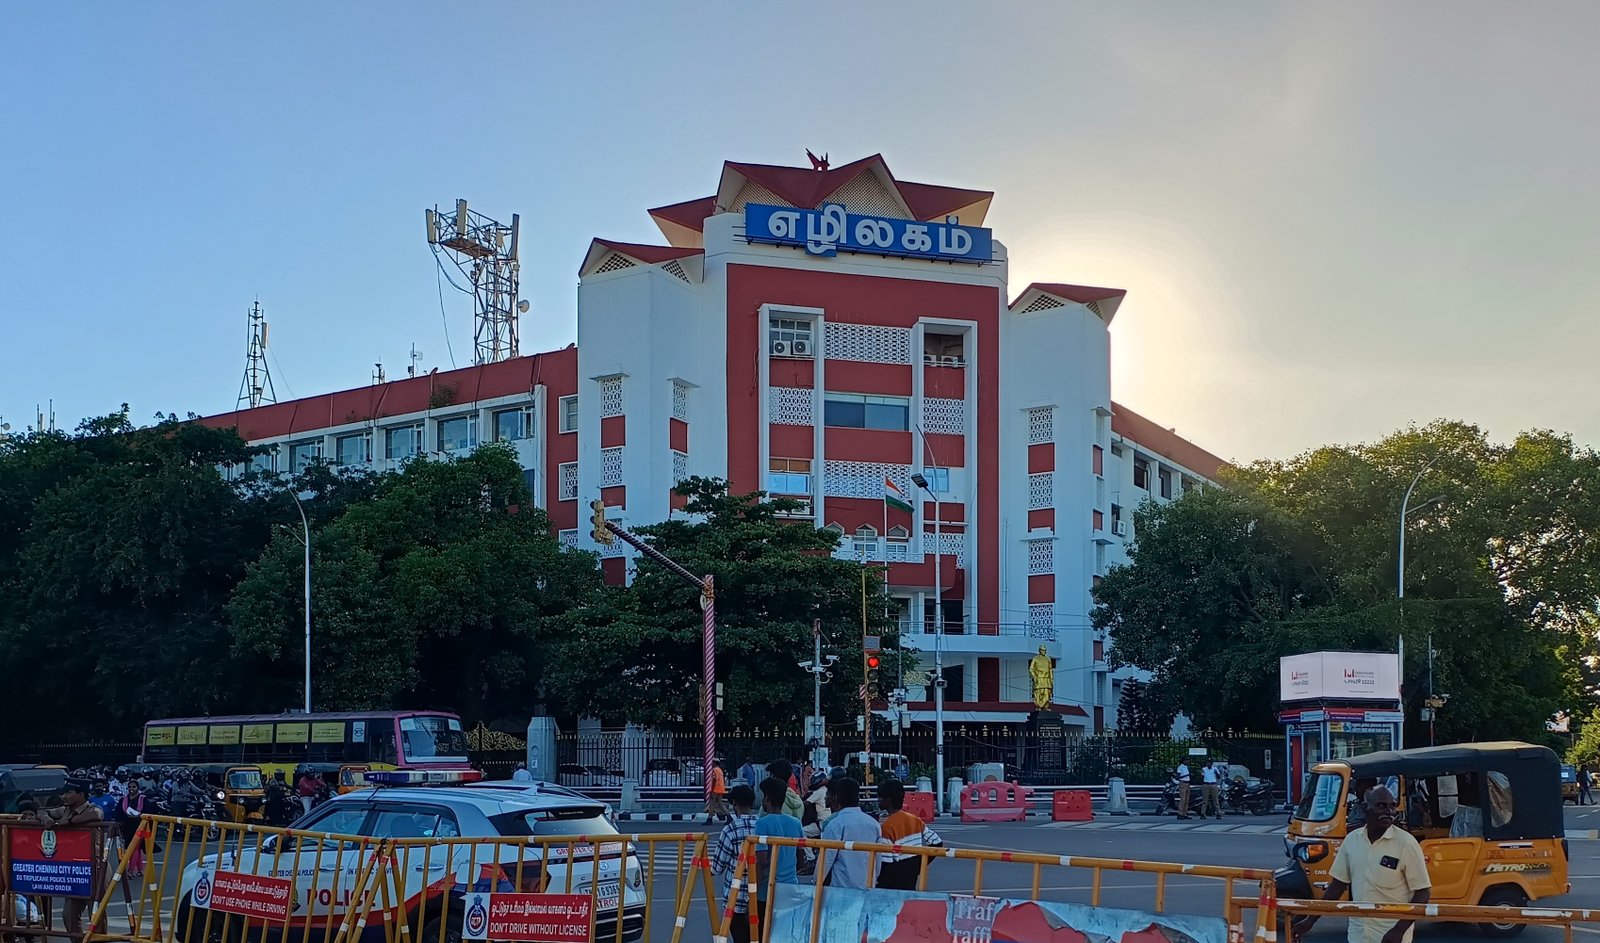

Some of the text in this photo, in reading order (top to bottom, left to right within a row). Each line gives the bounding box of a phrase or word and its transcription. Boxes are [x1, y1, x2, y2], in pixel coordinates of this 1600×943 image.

[768, 203, 973, 255] எழிலகம்
[556, 847, 587, 855] GRETER
[12, 863, 92, 876] GREATER CHENNAI CITY POLICE
[212, 894, 286, 915] DON'T USE PHONE WHILE DRIVING
[490, 922, 587, 936] DON'T DRIVE WITHOUT LICENSE
